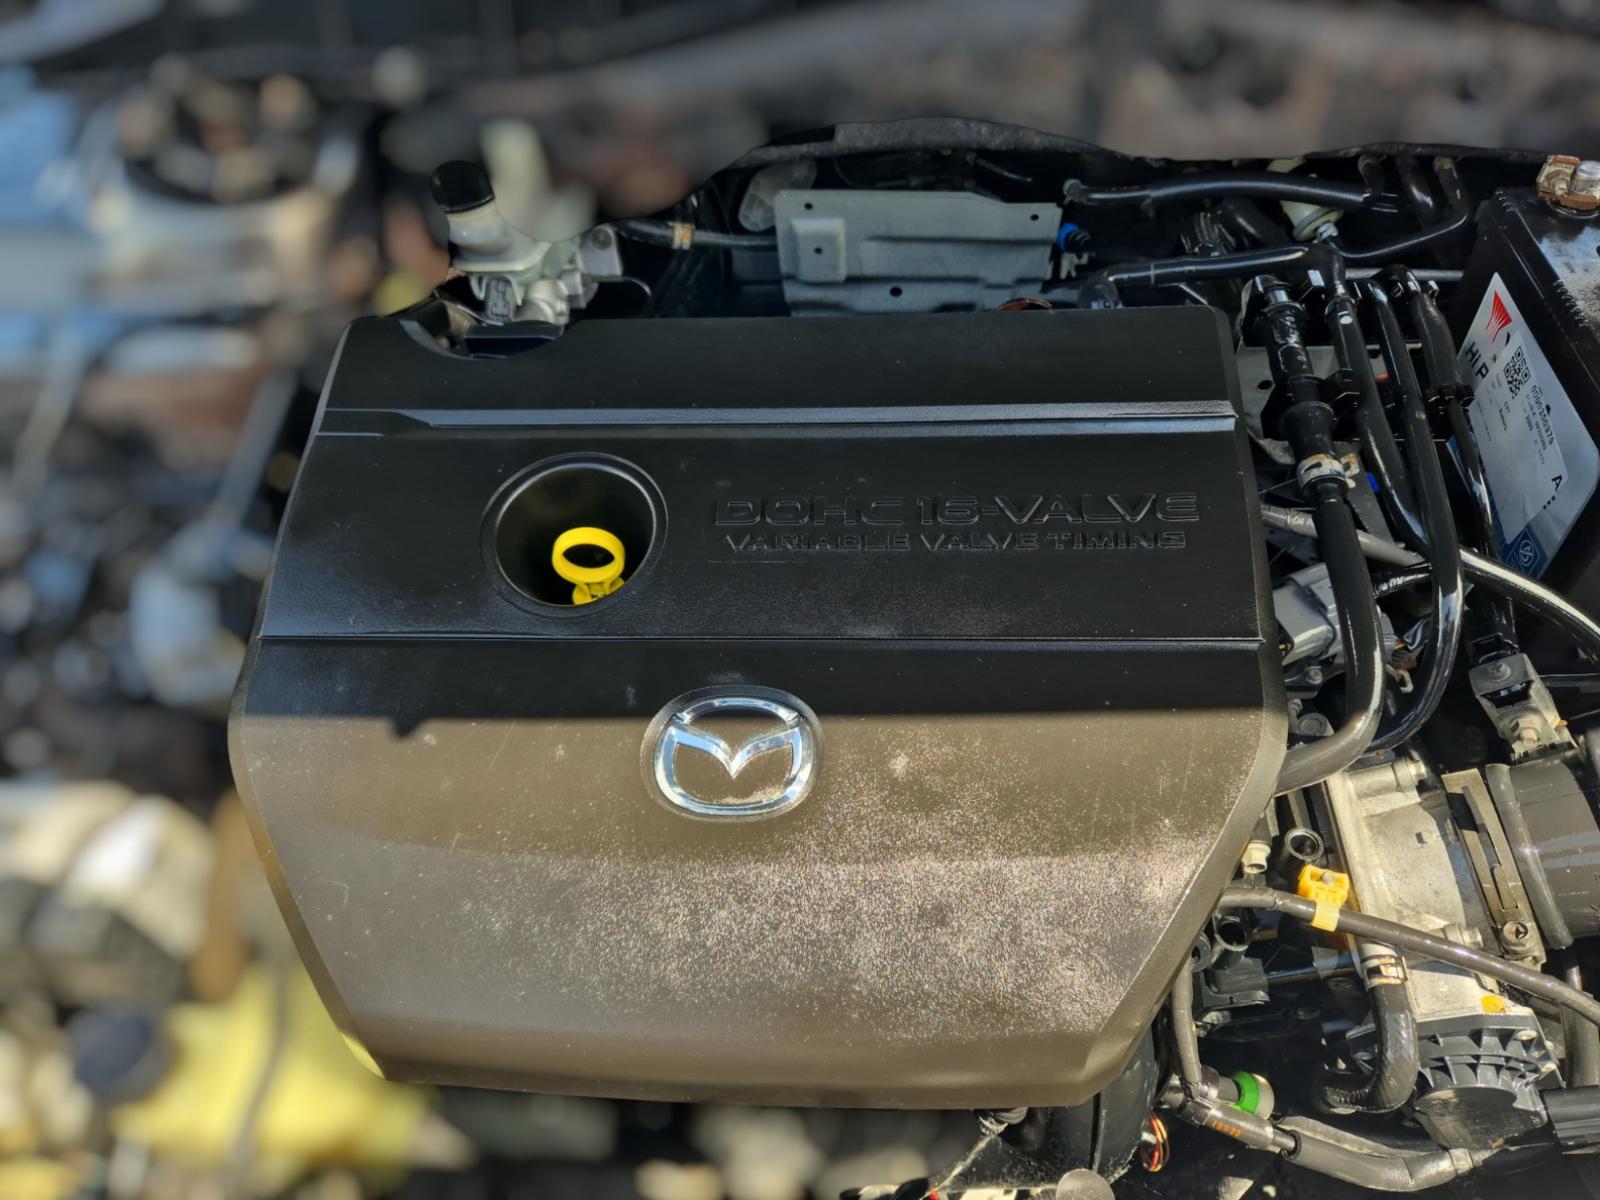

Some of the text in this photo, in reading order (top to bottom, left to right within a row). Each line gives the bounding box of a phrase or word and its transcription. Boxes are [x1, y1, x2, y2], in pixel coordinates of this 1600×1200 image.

[1552, 475, 1563, 491] A
[714, 492, 1200, 527] DOHC 16-VALVE
[724, 529, 1187, 552] VARIABLE VALVE TIMING
